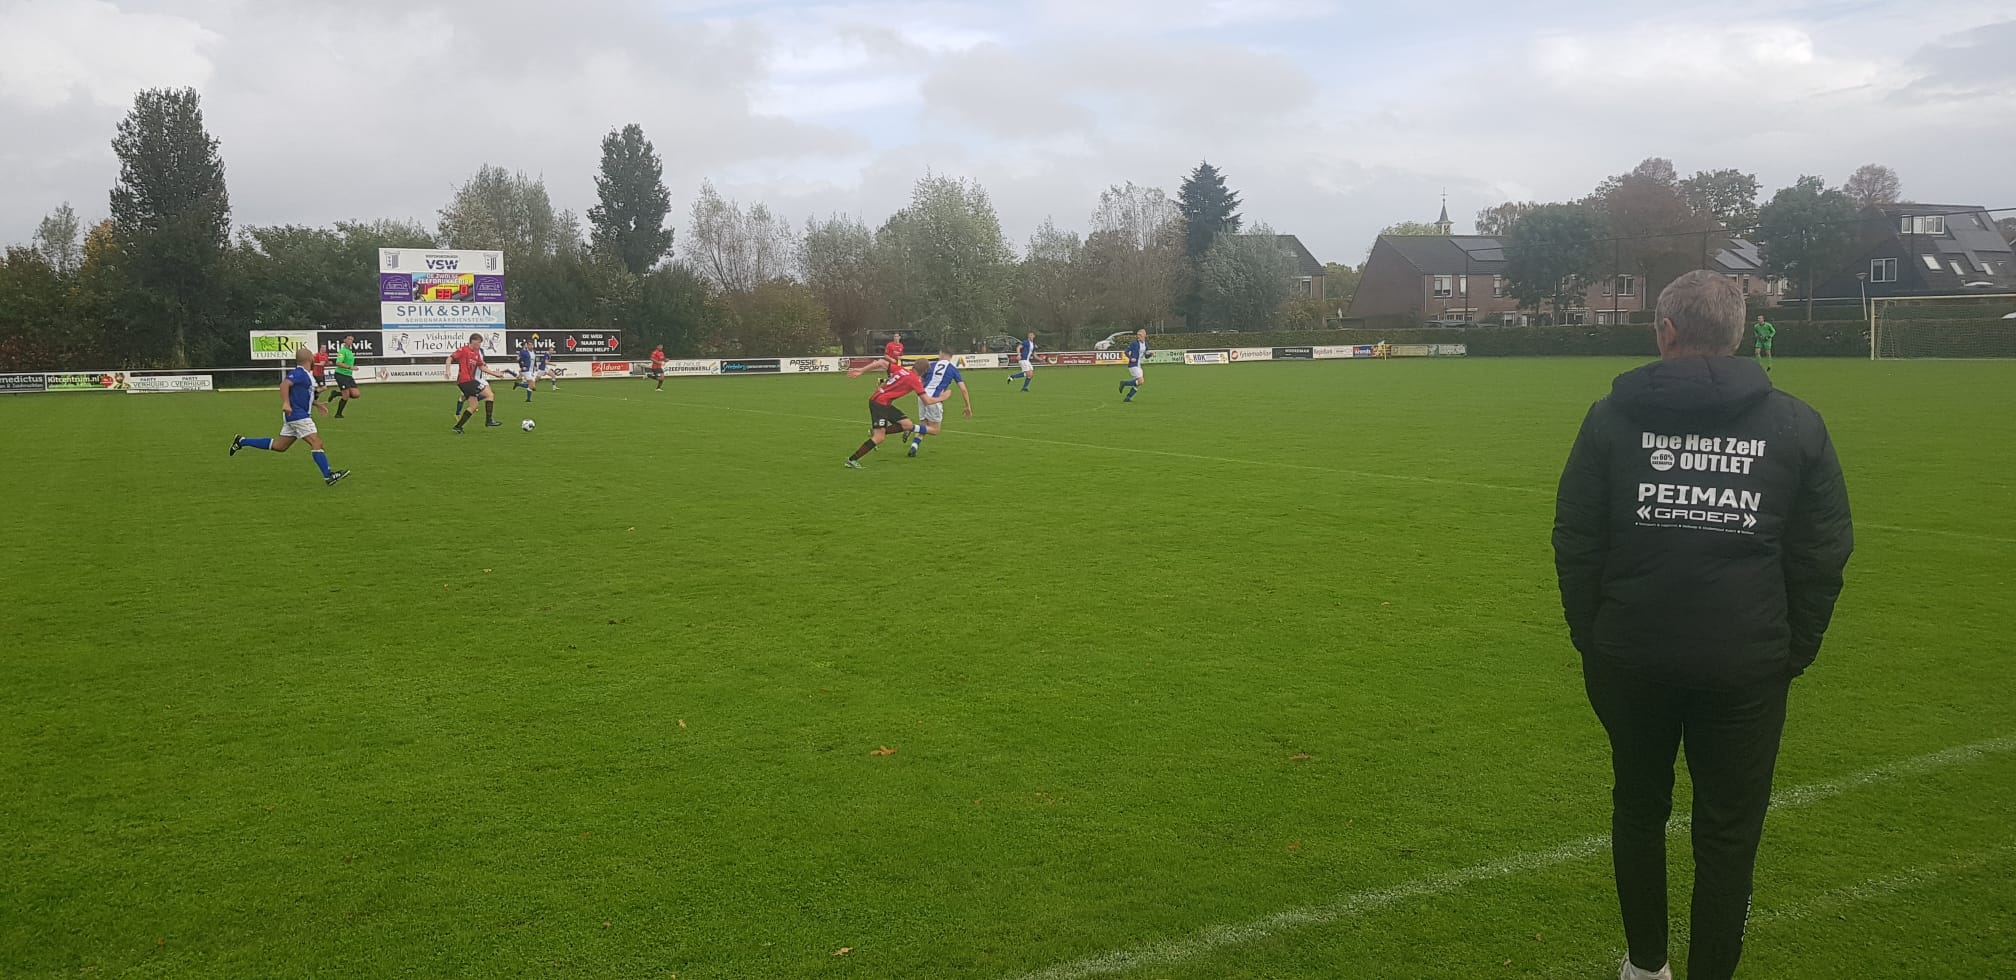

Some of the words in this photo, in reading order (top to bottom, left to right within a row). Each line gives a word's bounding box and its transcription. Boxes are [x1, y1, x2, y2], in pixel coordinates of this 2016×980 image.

[425, 259, 459, 270] VSW
[397, 305, 434, 317] SPIK
[437, 305, 449, 317] &
[451, 305, 492, 317] SPAN
[426, 332, 464, 341] Vishandel
[414, 339, 442, 350] Theo
[1096, 352, 1121, 360] KNOL
[799, 364, 829, 372] SPORTS
[935, 363, 945, 376] 2
[0, 375, 43, 384] nedictus
[1641, 431, 1682, 450] Doe
[1685, 433, 1722, 453] Het
[1724, 437, 1767, 457] Zelf
[1680, 452, 1754, 475] OUTLET
[1638, 482, 1761, 512] PEIMAN
[1654, 507, 1740, 524] GROEP
